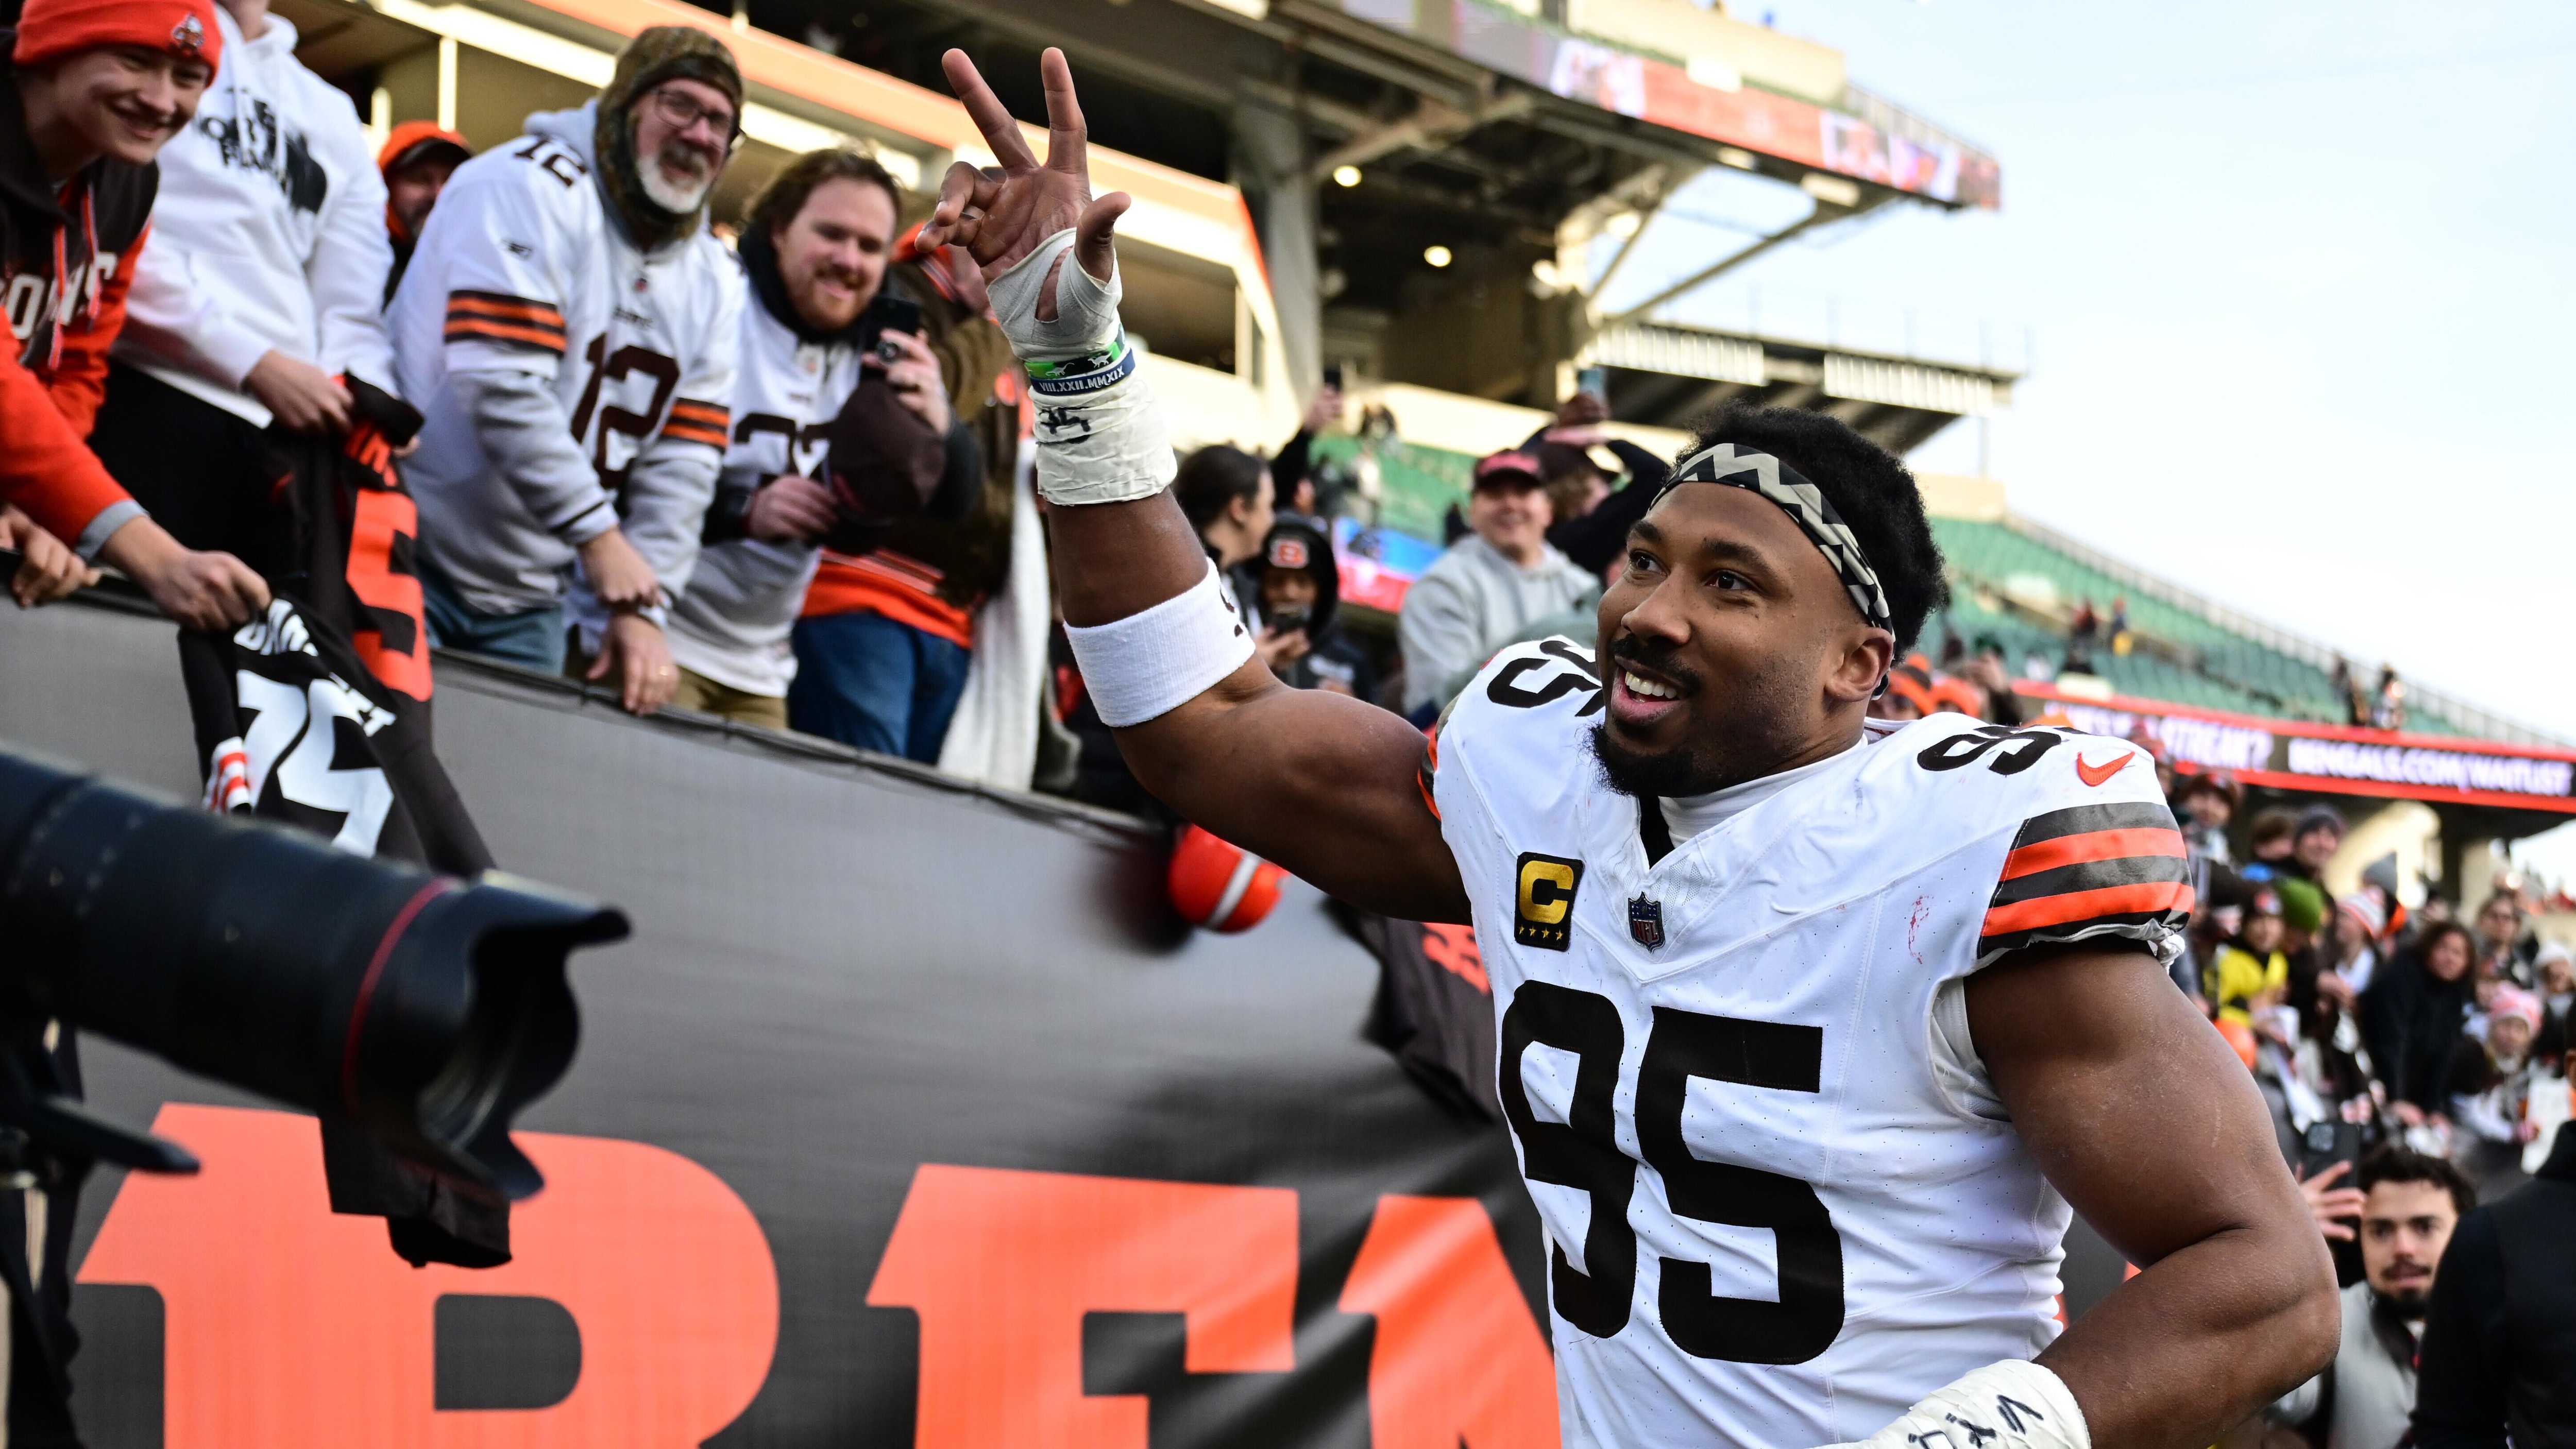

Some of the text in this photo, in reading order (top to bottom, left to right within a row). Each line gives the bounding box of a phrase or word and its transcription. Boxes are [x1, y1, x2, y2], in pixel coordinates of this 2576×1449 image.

[569, 332, 681, 491] 12
[1039, 365, 1125, 393] VIII.XXII.MMXIX
[1519, 860, 1574, 924] C
[1499, 979, 1845, 1365] 95
